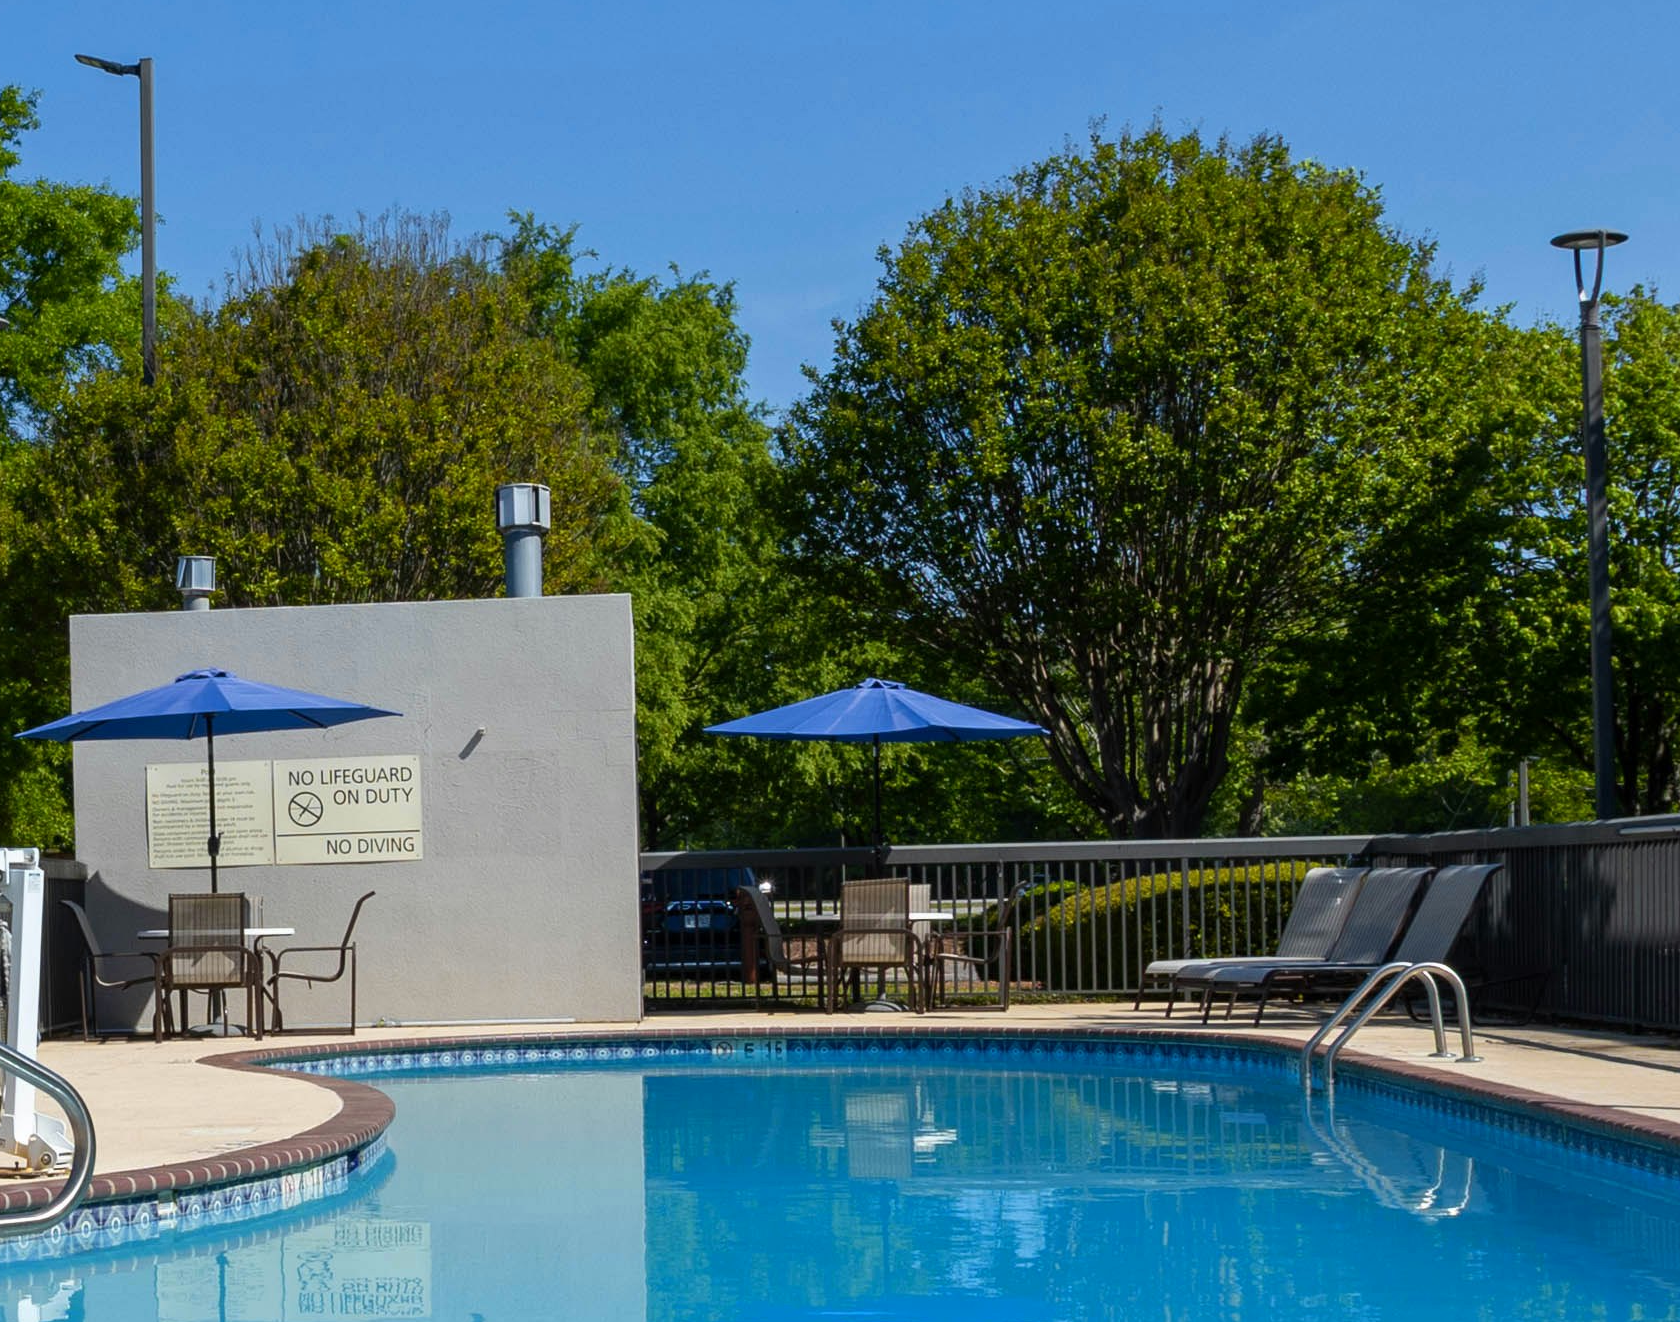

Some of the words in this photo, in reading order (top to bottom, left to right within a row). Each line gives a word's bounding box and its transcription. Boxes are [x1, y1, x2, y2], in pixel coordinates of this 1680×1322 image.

[288, 770, 314, 786] NO
[320, 767, 412, 785] LIFEGUARD
[333, 789, 359, 805] ON
[366, 787, 413, 804] DUTY
[327, 838, 351, 855] NO
[358, 837, 415, 854] DIVING
